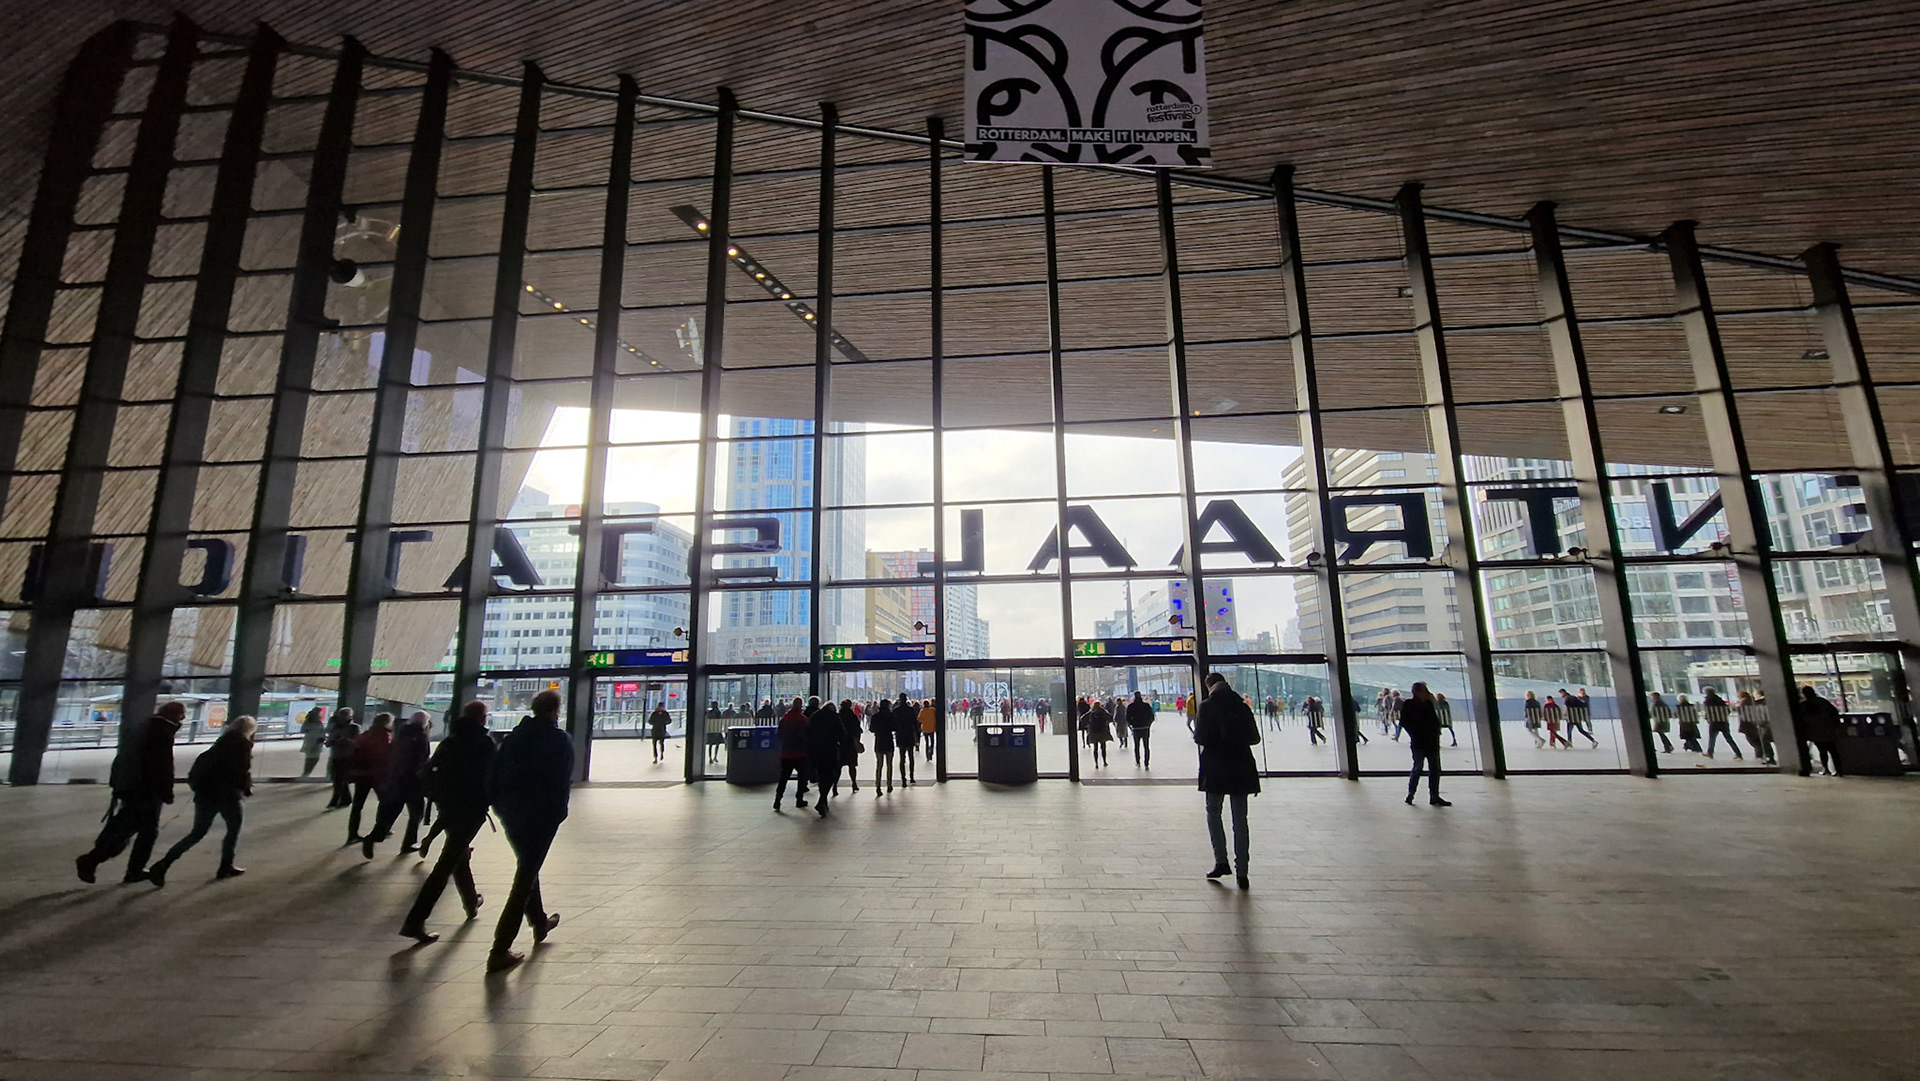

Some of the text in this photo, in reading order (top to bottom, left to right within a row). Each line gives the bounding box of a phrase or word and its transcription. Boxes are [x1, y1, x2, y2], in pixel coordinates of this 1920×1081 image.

[1146, 103, 1190, 112] rotterdam
[1147, 110, 1193, 123] festivals
[978, 128, 1195, 142] ROTTERDAM. MAKE IT HAPPEN.
